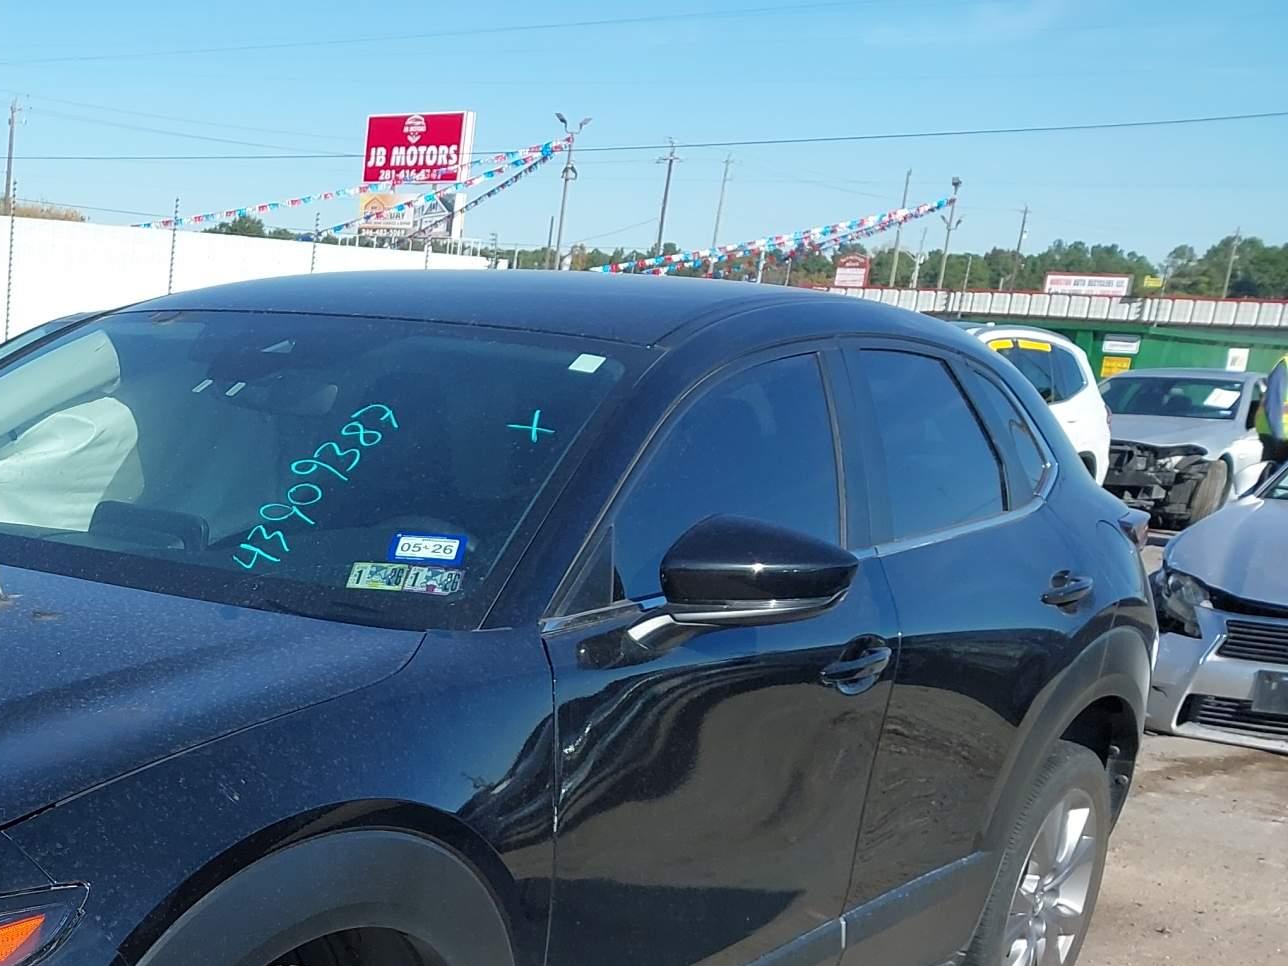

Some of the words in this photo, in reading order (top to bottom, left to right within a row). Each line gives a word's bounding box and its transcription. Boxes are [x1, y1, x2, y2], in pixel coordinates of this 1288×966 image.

[367, 146, 387, 167] JB
[390, 144, 458, 167] MOTORS
[232, 404, 399, 569] 43909387
